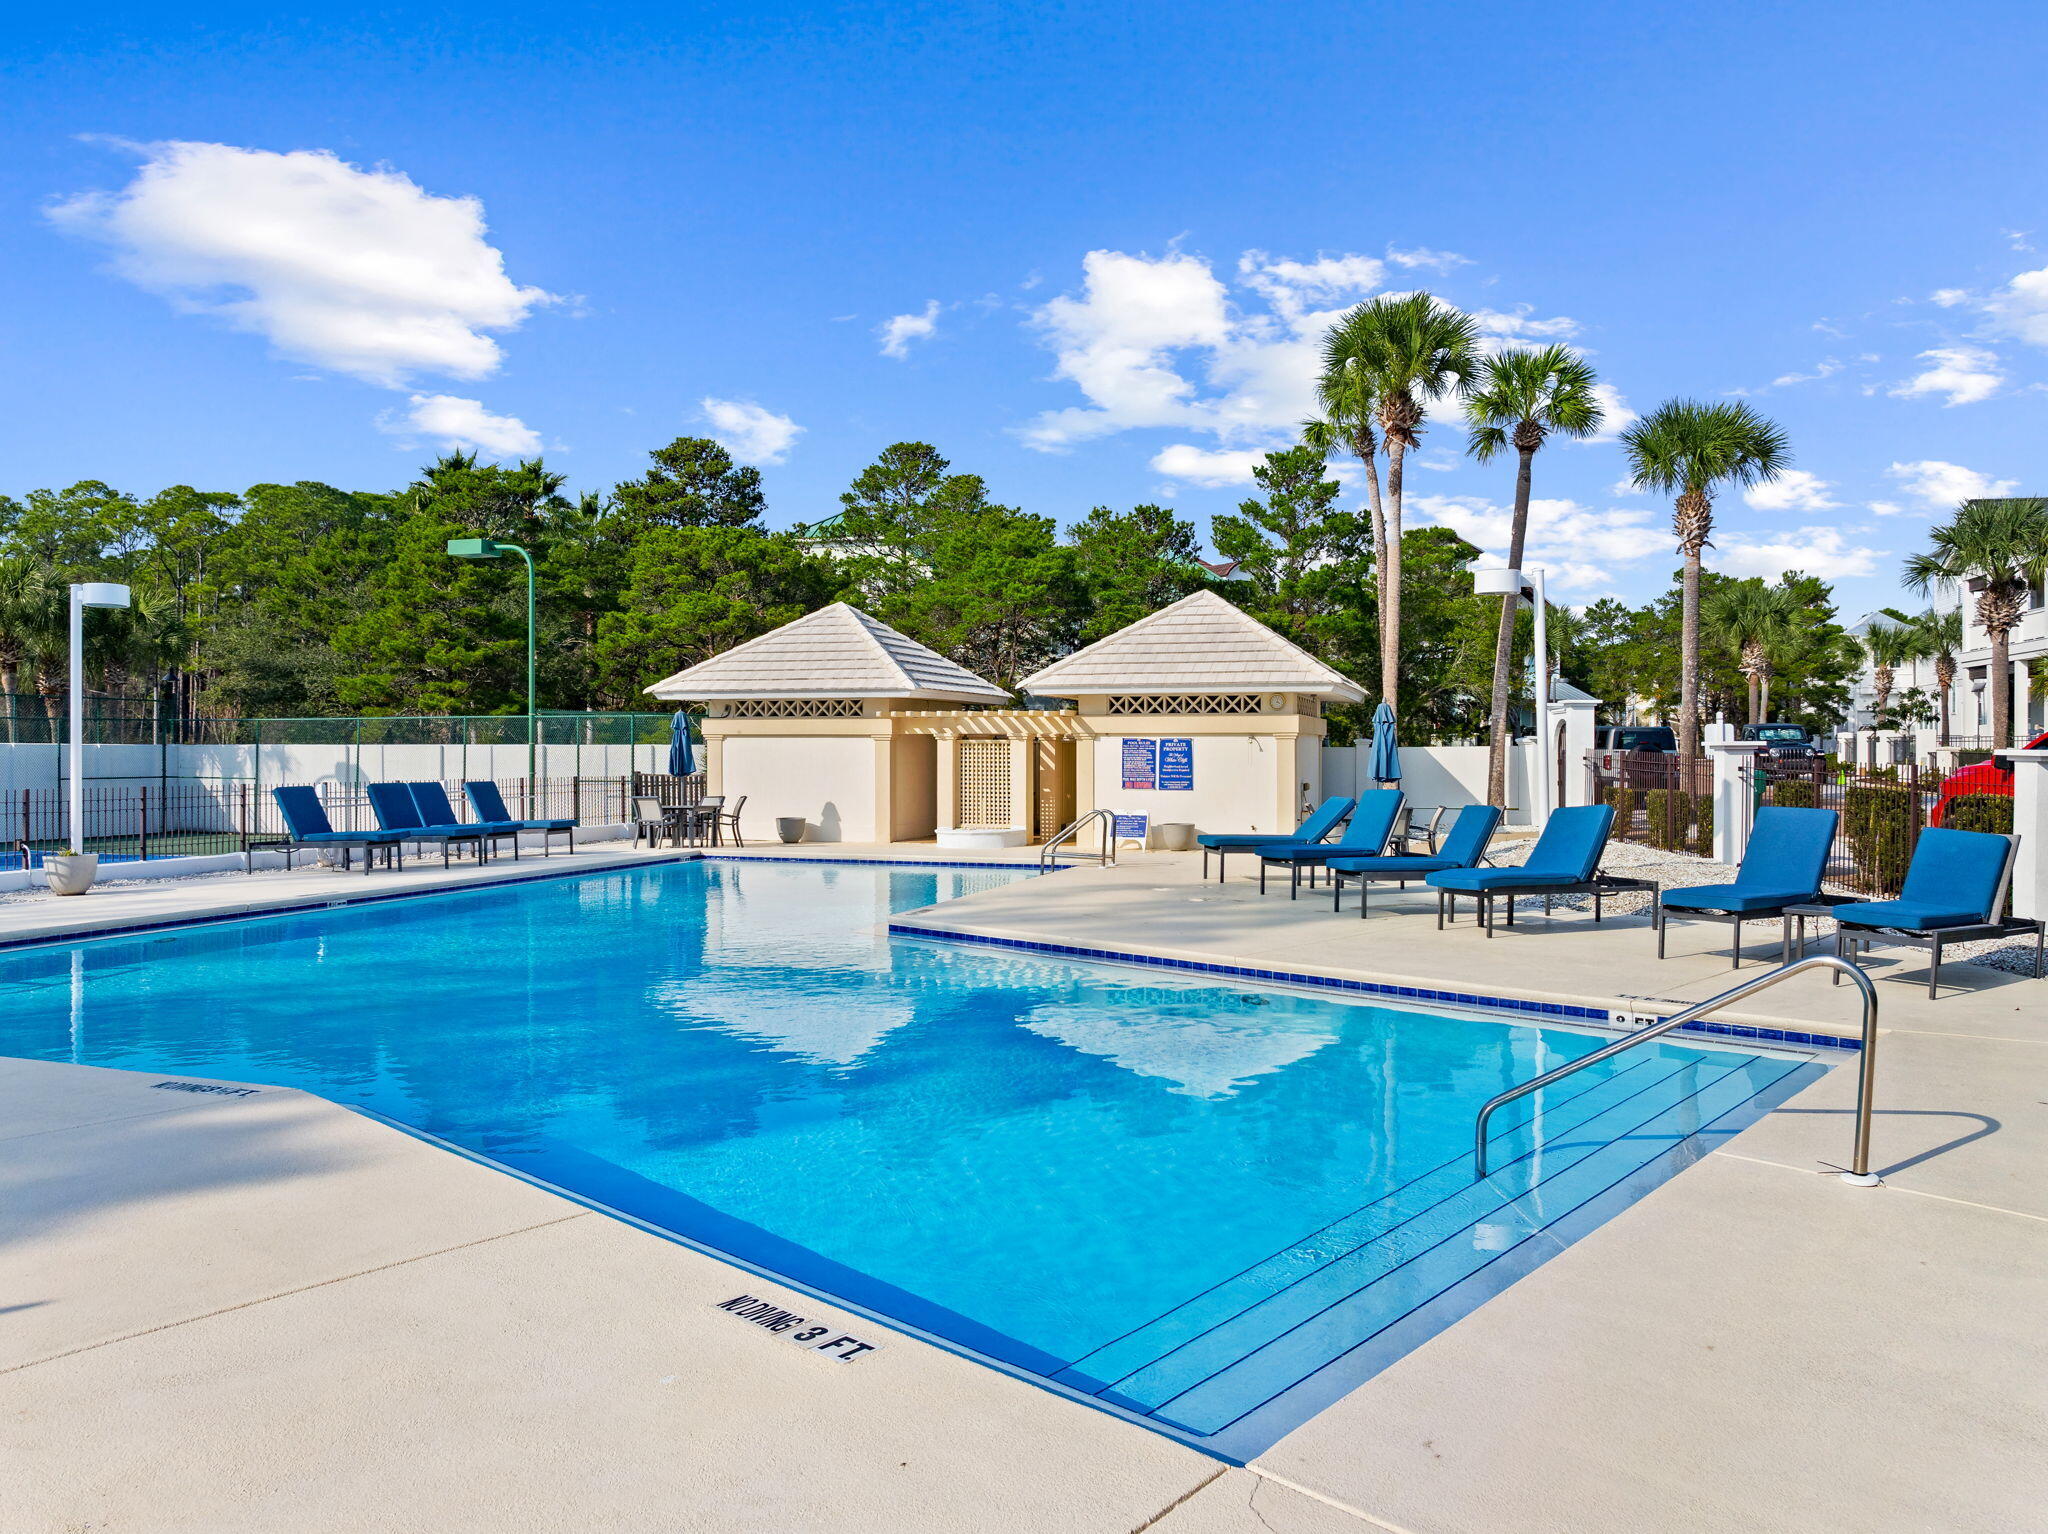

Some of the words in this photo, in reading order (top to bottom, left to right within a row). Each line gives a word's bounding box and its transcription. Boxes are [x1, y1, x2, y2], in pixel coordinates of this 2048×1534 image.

[716, 1294, 759, 1312] NO
[735, 1302, 805, 1332] DIVING
[793, 1326, 829, 1342] 3
[817, 1336, 876, 1361] FT.
